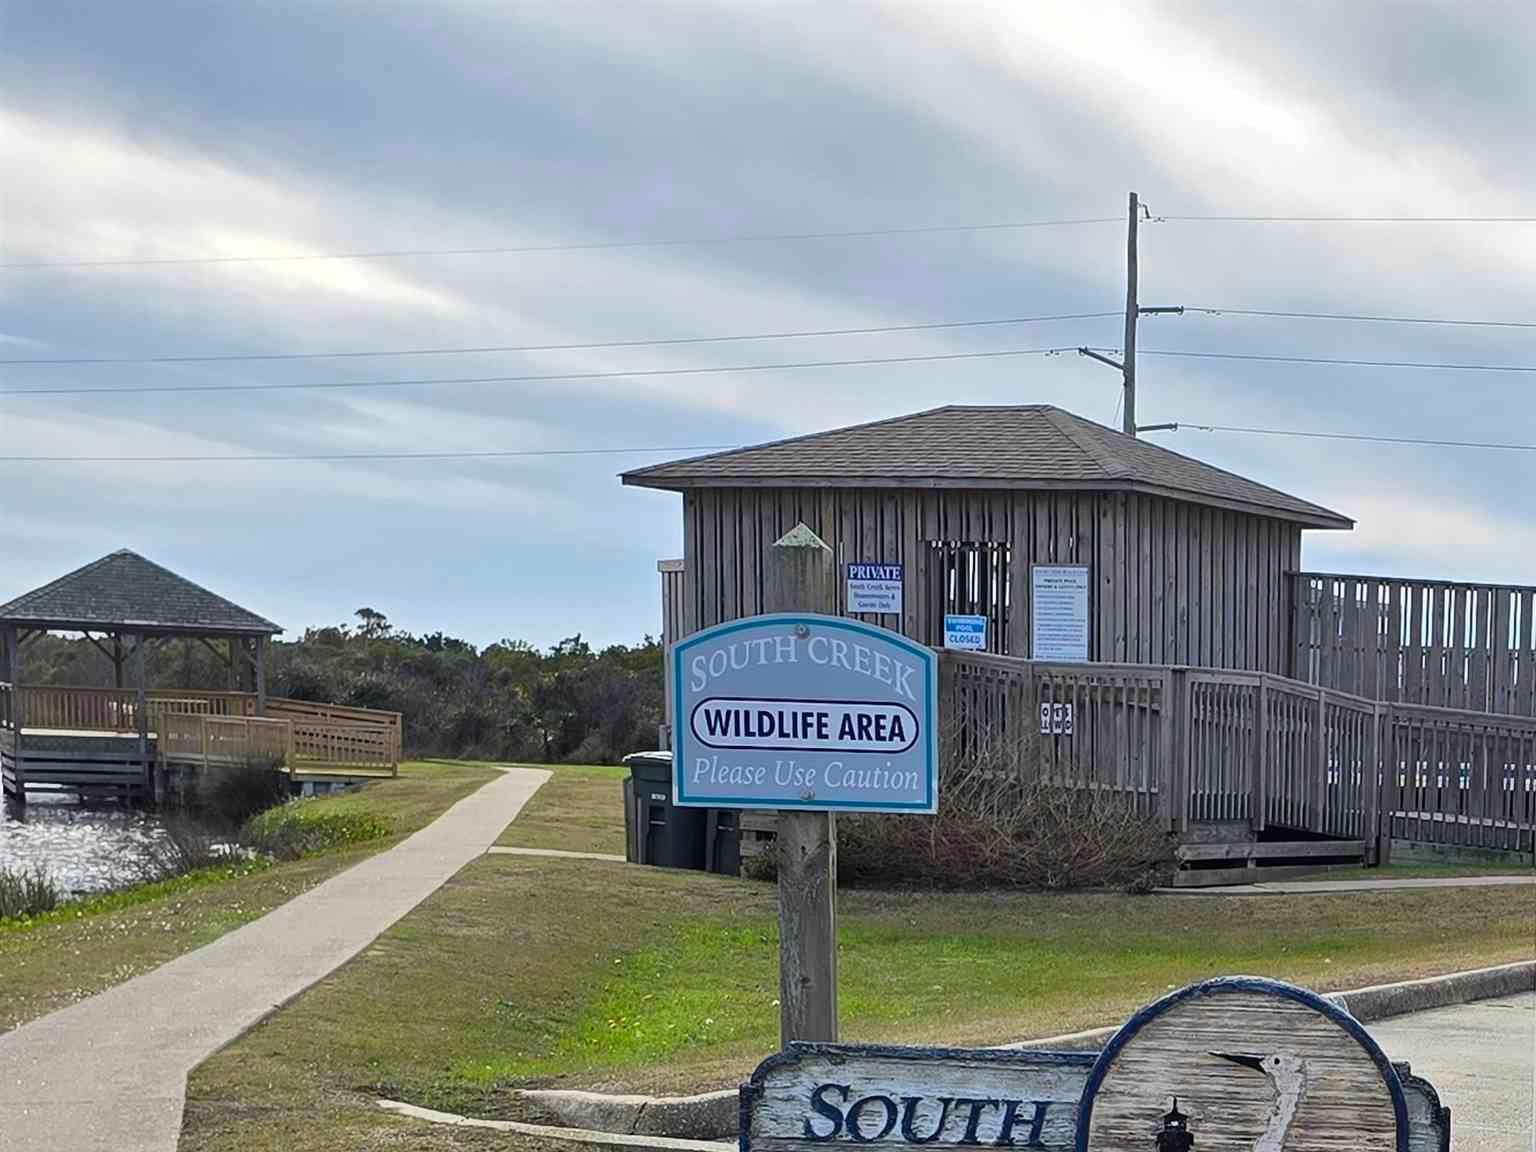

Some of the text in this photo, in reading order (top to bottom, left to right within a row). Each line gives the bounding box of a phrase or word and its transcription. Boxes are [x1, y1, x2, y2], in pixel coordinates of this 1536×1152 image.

[849, 565, 901, 580] PRIVATE
[949, 634, 981, 645] CLOSED
[691, 635, 917, 700] SOUTH CREEK
[704, 708, 906, 742] WILDLIFE AREA
[693, 756, 919, 789] Please Use Caution
[803, 1083, 1048, 1146] SOUTH
